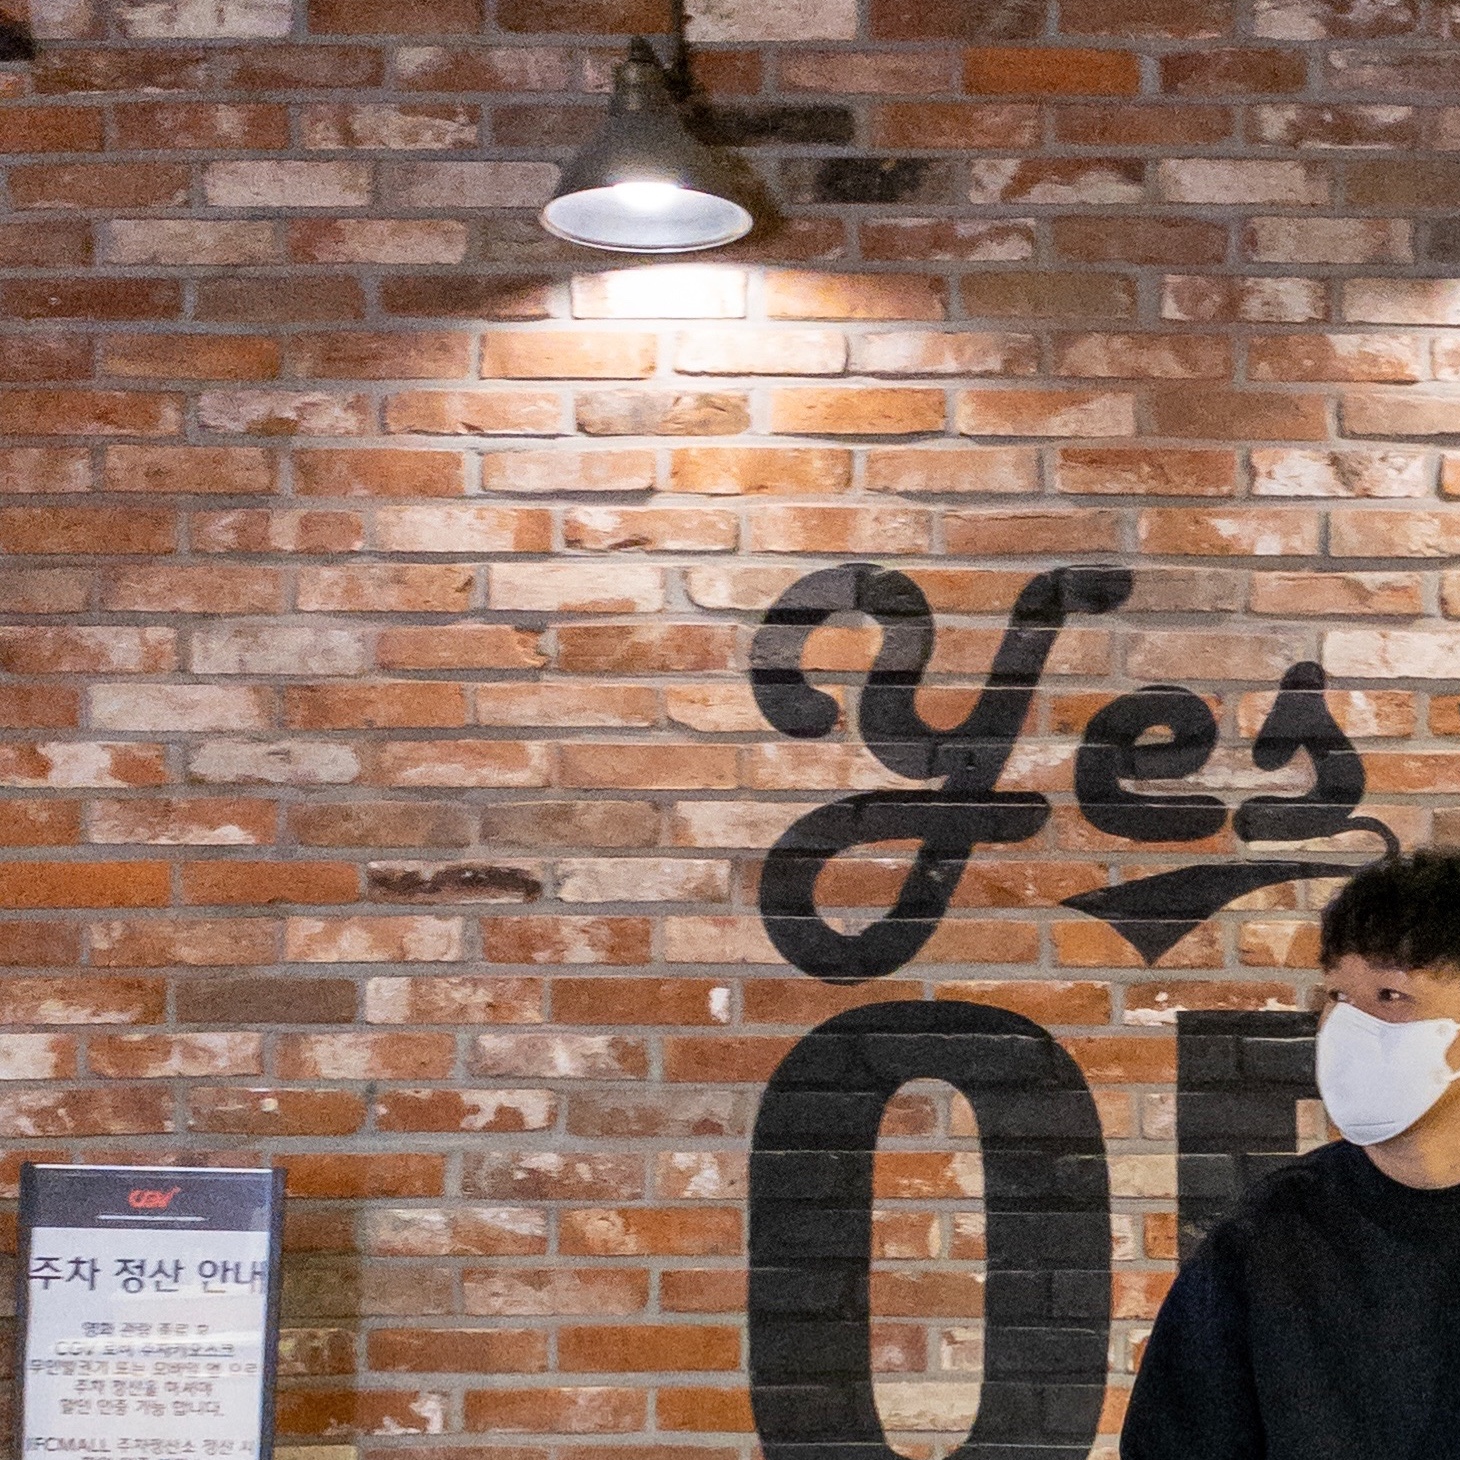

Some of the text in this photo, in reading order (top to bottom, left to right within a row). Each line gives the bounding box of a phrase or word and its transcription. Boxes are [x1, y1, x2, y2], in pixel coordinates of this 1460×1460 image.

[29, 1256, 266, 1295] 주차 정산 안내
